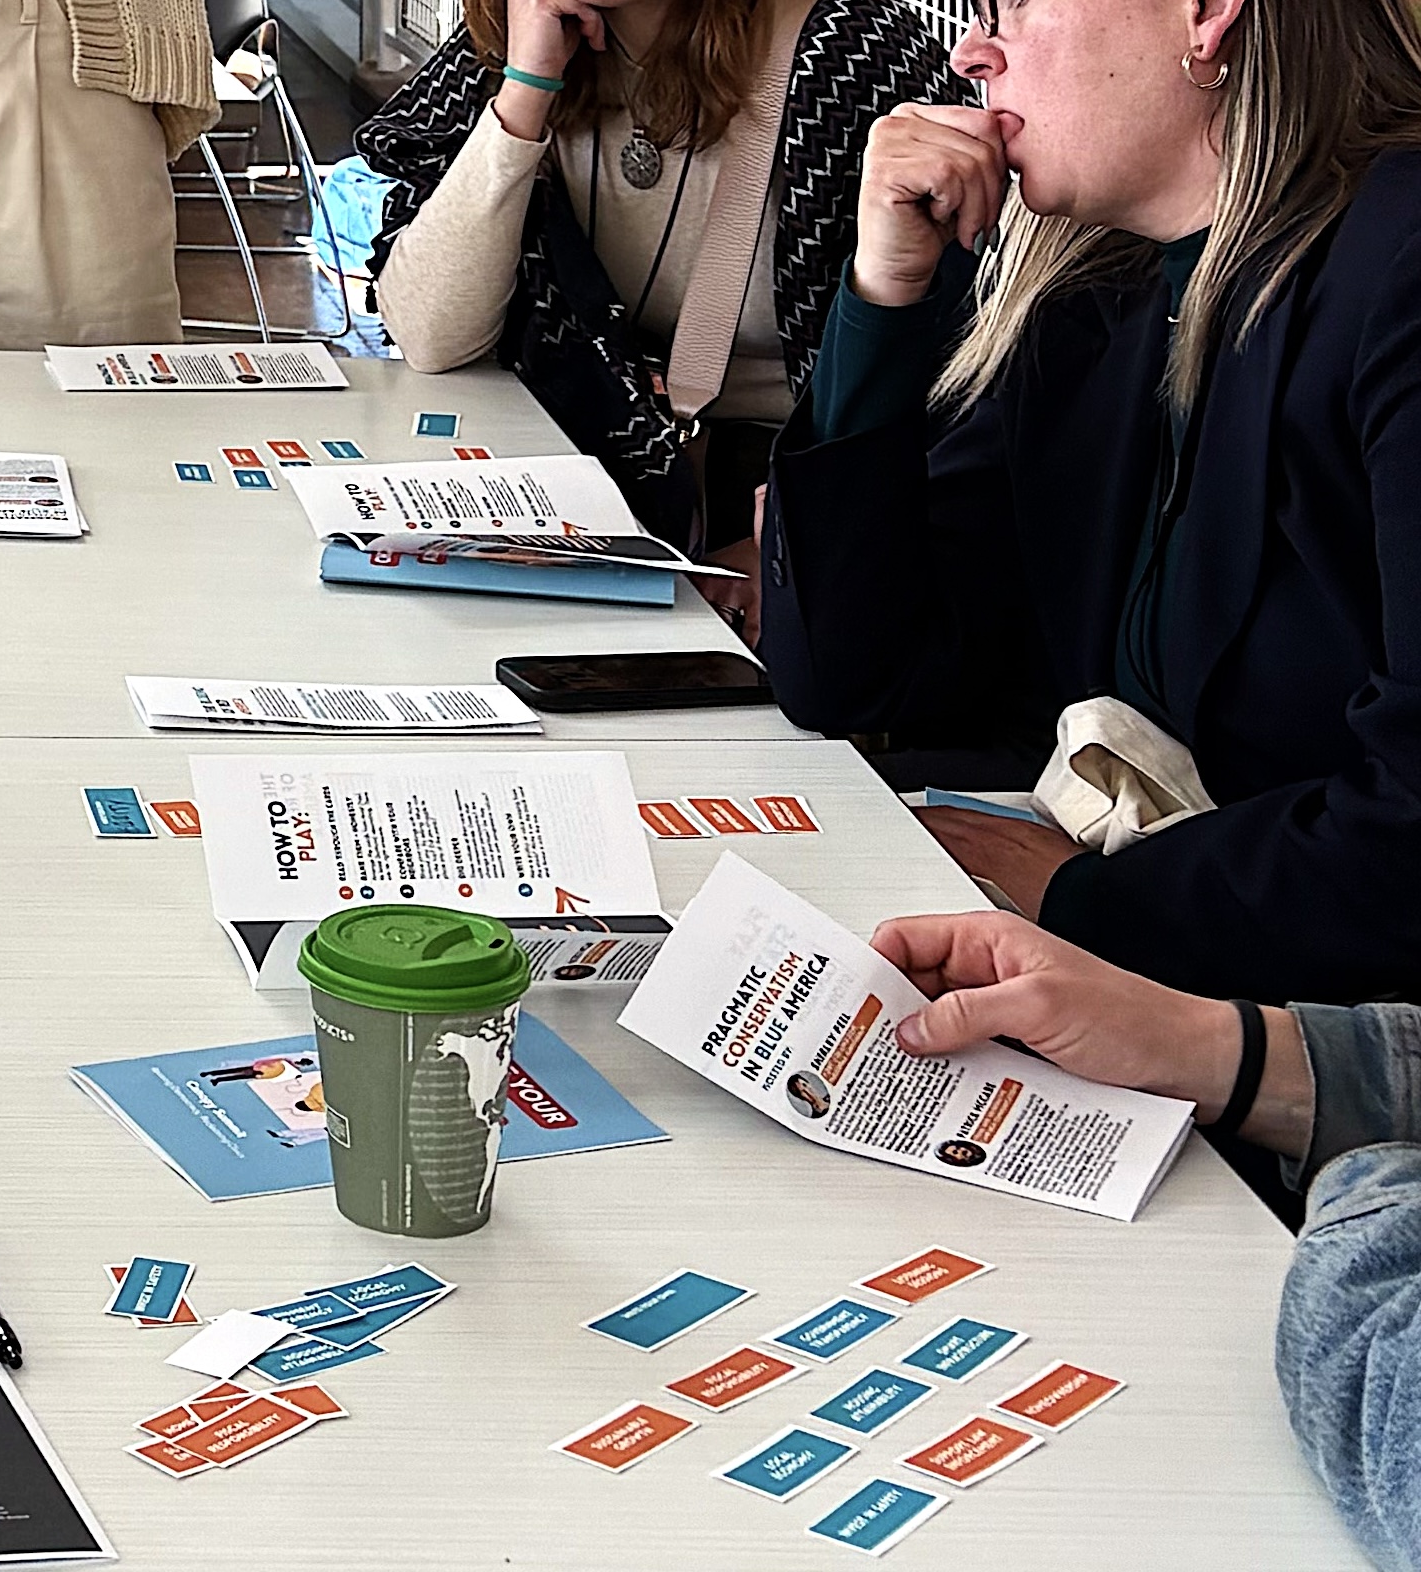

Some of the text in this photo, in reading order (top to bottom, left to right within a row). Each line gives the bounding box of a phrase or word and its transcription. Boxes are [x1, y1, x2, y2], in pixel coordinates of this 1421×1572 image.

[344, 483, 376, 520] HOW TO
[267, 801, 299, 880] HOW TO
[291, 812, 317, 861] PLAY:
[701, 965, 767, 1057] PRAGMATIC
[723, 951, 803, 1068] CONSERVATISM
[740, 953, 830, 1082] IN BLUE AMERICA
[509, 1077, 567, 1124] YOUR
